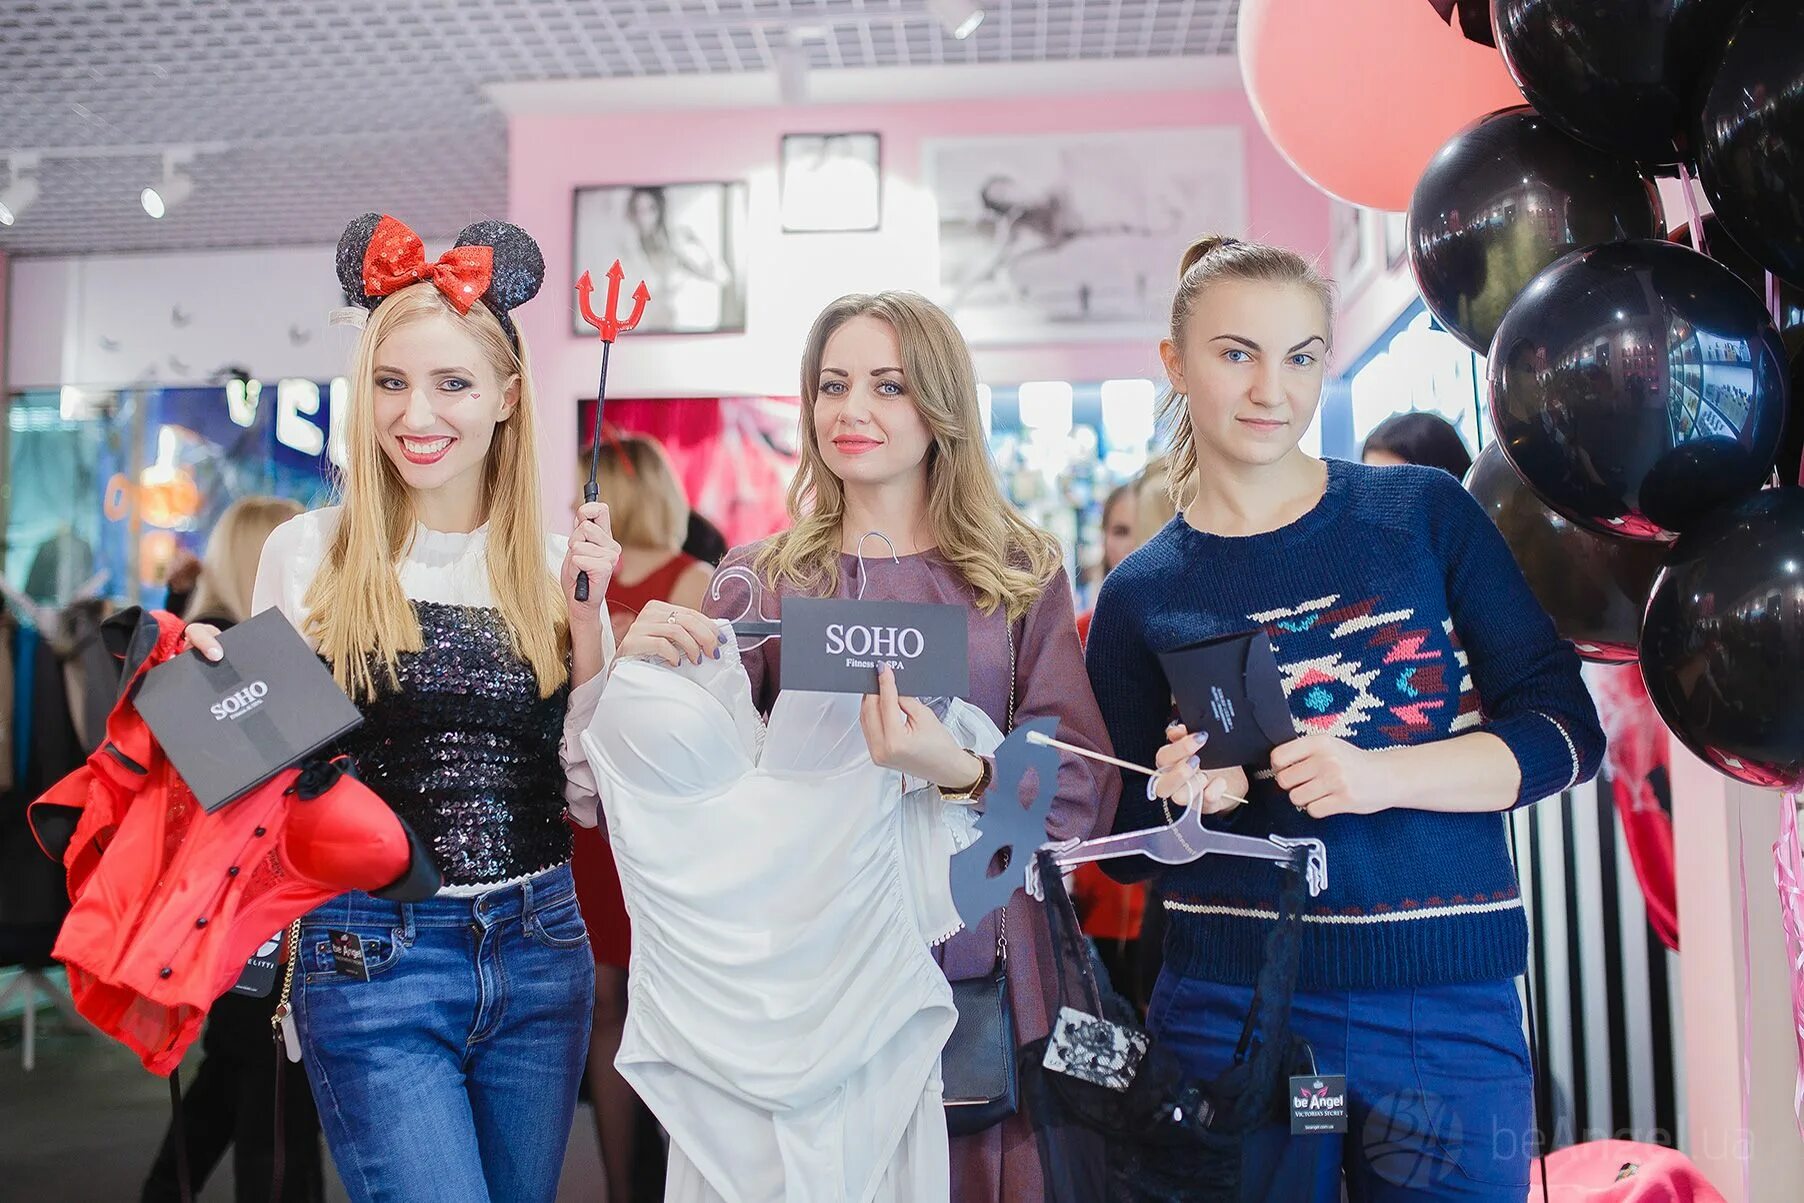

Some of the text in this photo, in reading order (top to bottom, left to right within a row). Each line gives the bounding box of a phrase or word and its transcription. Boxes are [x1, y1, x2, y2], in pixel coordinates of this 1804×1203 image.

[825, 623, 925, 658] SOHO
[845, 657, 875, 669] Fitness
[209, 680, 269, 721] SOHO
[1293, 1093, 1344, 1110] be Angel
